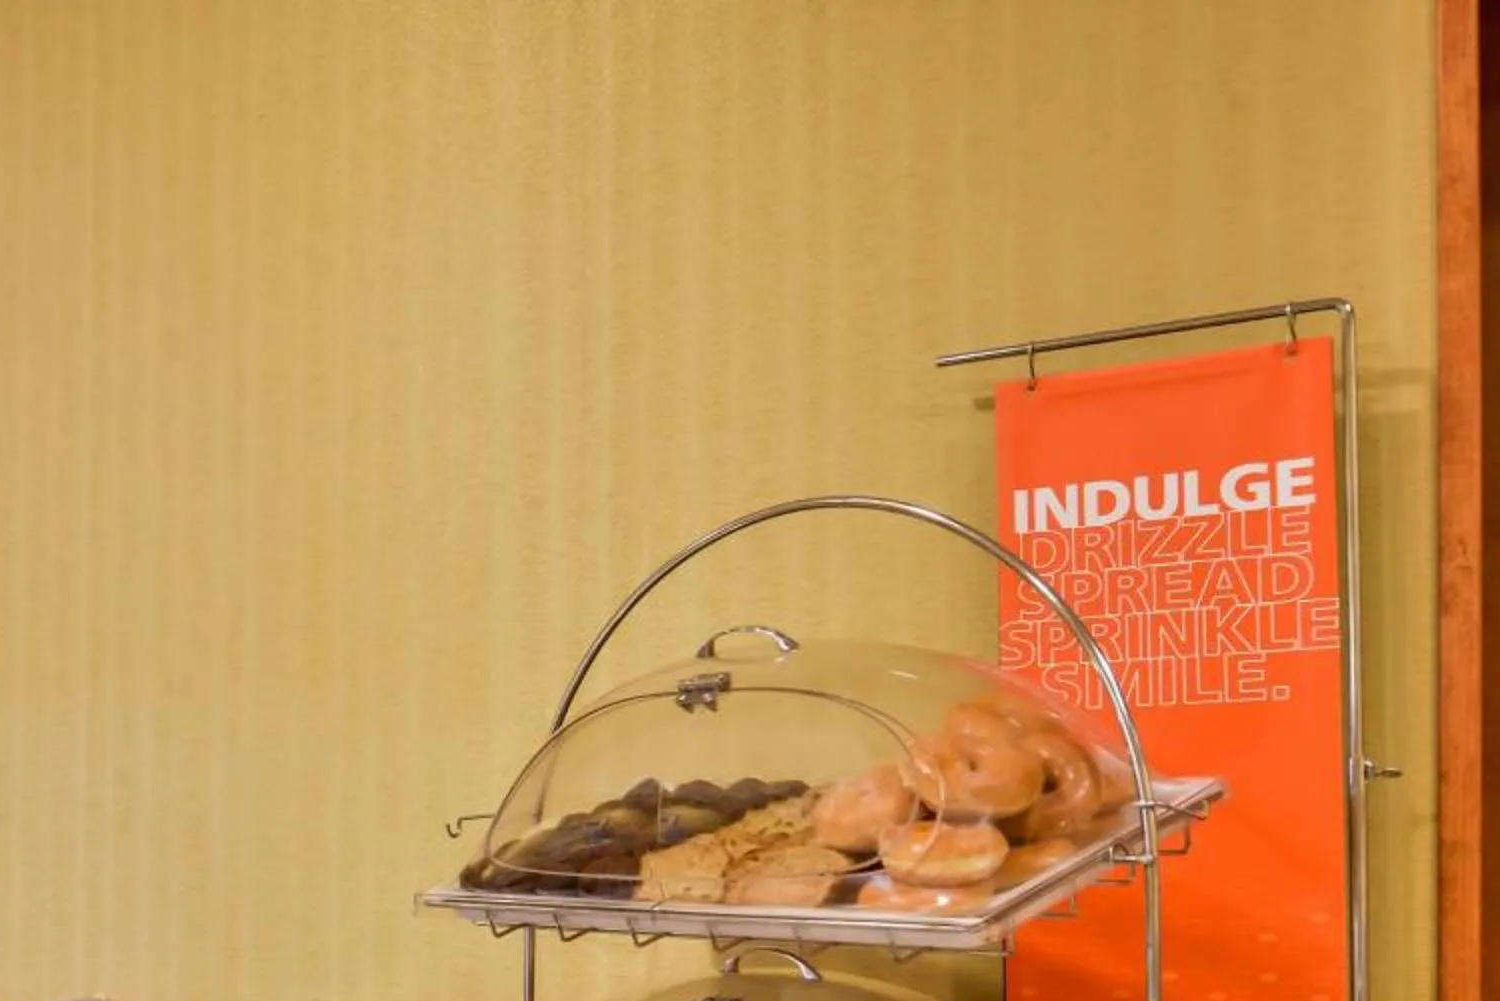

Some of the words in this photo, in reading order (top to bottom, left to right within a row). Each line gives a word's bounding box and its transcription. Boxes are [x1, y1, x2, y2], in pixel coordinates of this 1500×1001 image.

[1013, 456, 1317, 533] INDULGE
[1019, 506, 1312, 575] DRIZZLE
[1017, 552, 1315, 622] SPREAD
[999, 597, 1340, 671] SPRINKLE
[1041, 651, 1291, 710] SMILE.
